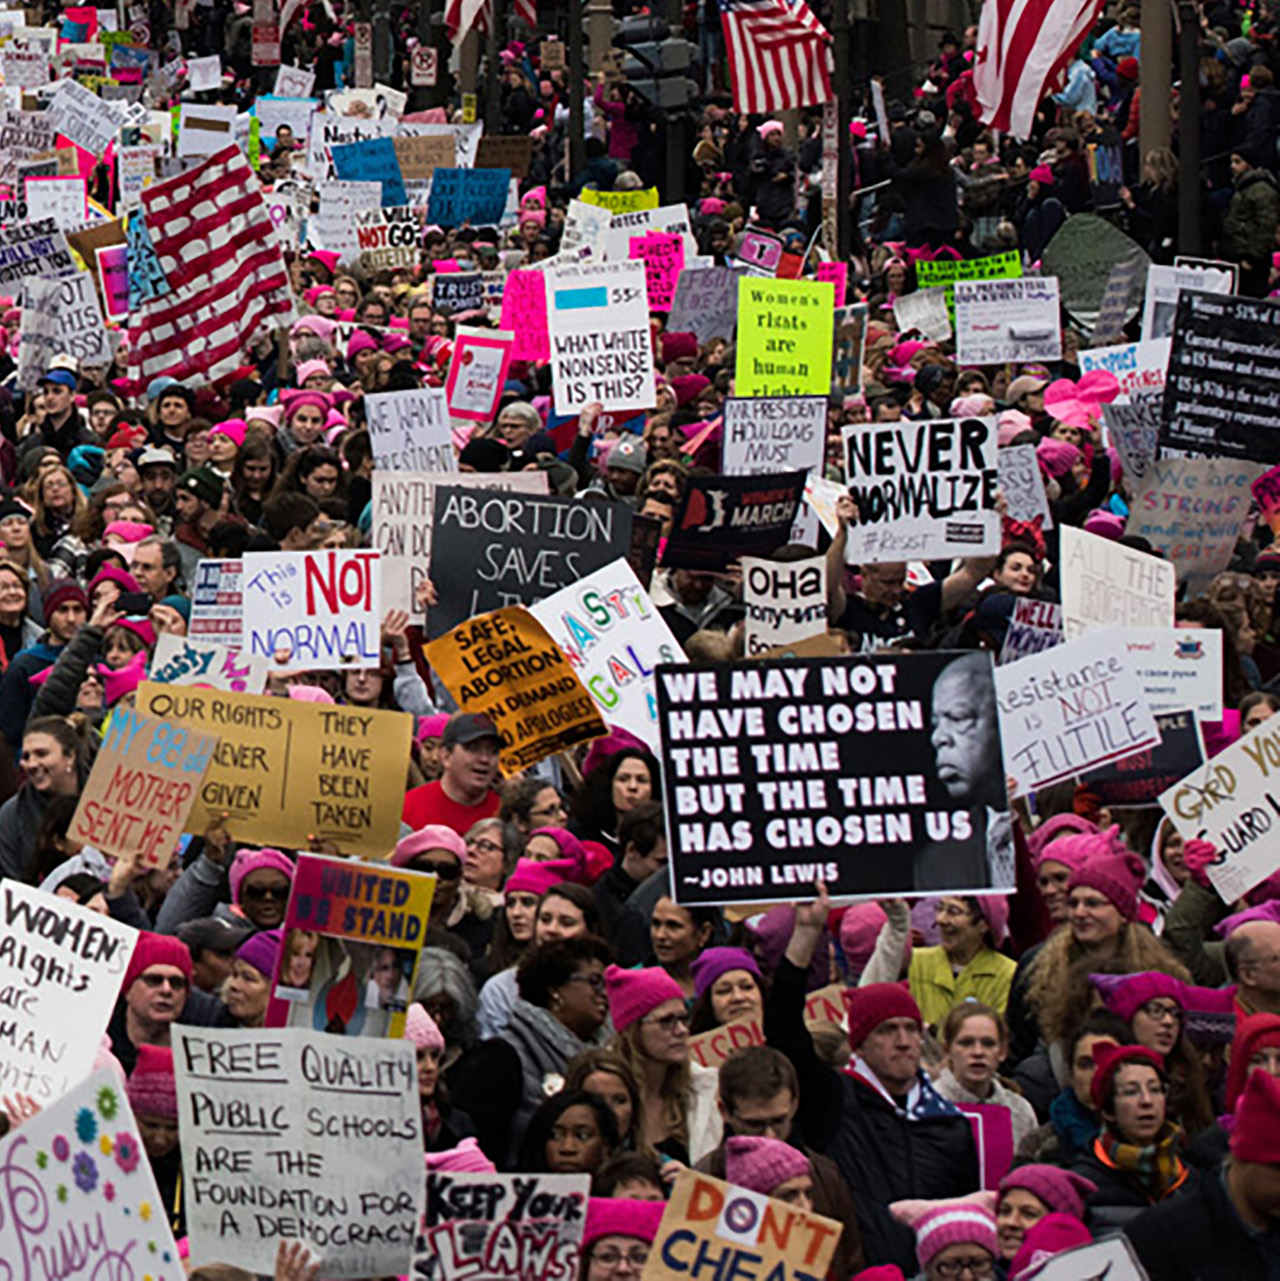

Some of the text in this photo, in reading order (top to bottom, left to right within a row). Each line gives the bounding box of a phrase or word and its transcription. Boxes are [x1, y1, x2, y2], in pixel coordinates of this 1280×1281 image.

[4, 202, 27, 218] NO
[31, 237, 56, 255] NOT
[358, 225, 415, 248] NOT GO
[751, 290, 820, 304] Women's
[555, 330, 647, 355] WHAT WHITE
[765, 338, 796, 352] are
[559, 355, 648, 378] NONSENSE
[753, 358, 809, 377] human
[567, 376, 644, 403] IS THIS?
[745, 443, 793, 463] MUST
[847, 422, 991, 479] NEVER
[730, 500, 796, 526] MARCH
[849, 470, 998, 528] NORMALIZE
[1144, 491, 1239, 514] STRONG
[441, 495, 613, 542] ABORTION
[477, 544, 583, 590] SAVES
[273, 585, 293, 608] is
[303, 555, 373, 616] NOT
[1016, 600, 1057, 629] WELL
[454, 619, 516, 651] SAFE,
[459, 645, 563, 703] ABORTION
[662, 665, 897, 702] WE MAY NOT
[320, 711, 373, 738] THEY
[669, 701, 923, 741] HAVE CHOSEN
[1012, 701, 1147, 779] FUTILE
[320, 745, 371, 771] HAVE
[670, 743, 839, 778] THE TIME
[109, 766, 193, 820] MOTHER
[202, 782, 262, 810] GIVEN
[319, 773, 370, 800] BEEN
[675, 776, 927, 815] BUT THE TIME
[310, 801, 372, 828] TAKEN
[680, 811, 973, 853] HAS CHOSEN US
[683, 862, 839, 889] ~JOHN LEWIS
[195, 1147, 324, 1178] ARE THE
[192, 1177, 418, 1217] FOUNDATION FOR
[219, 1213, 419, 1249] A DEMOCRACY
[685, 1178, 835, 1265] DON'T
